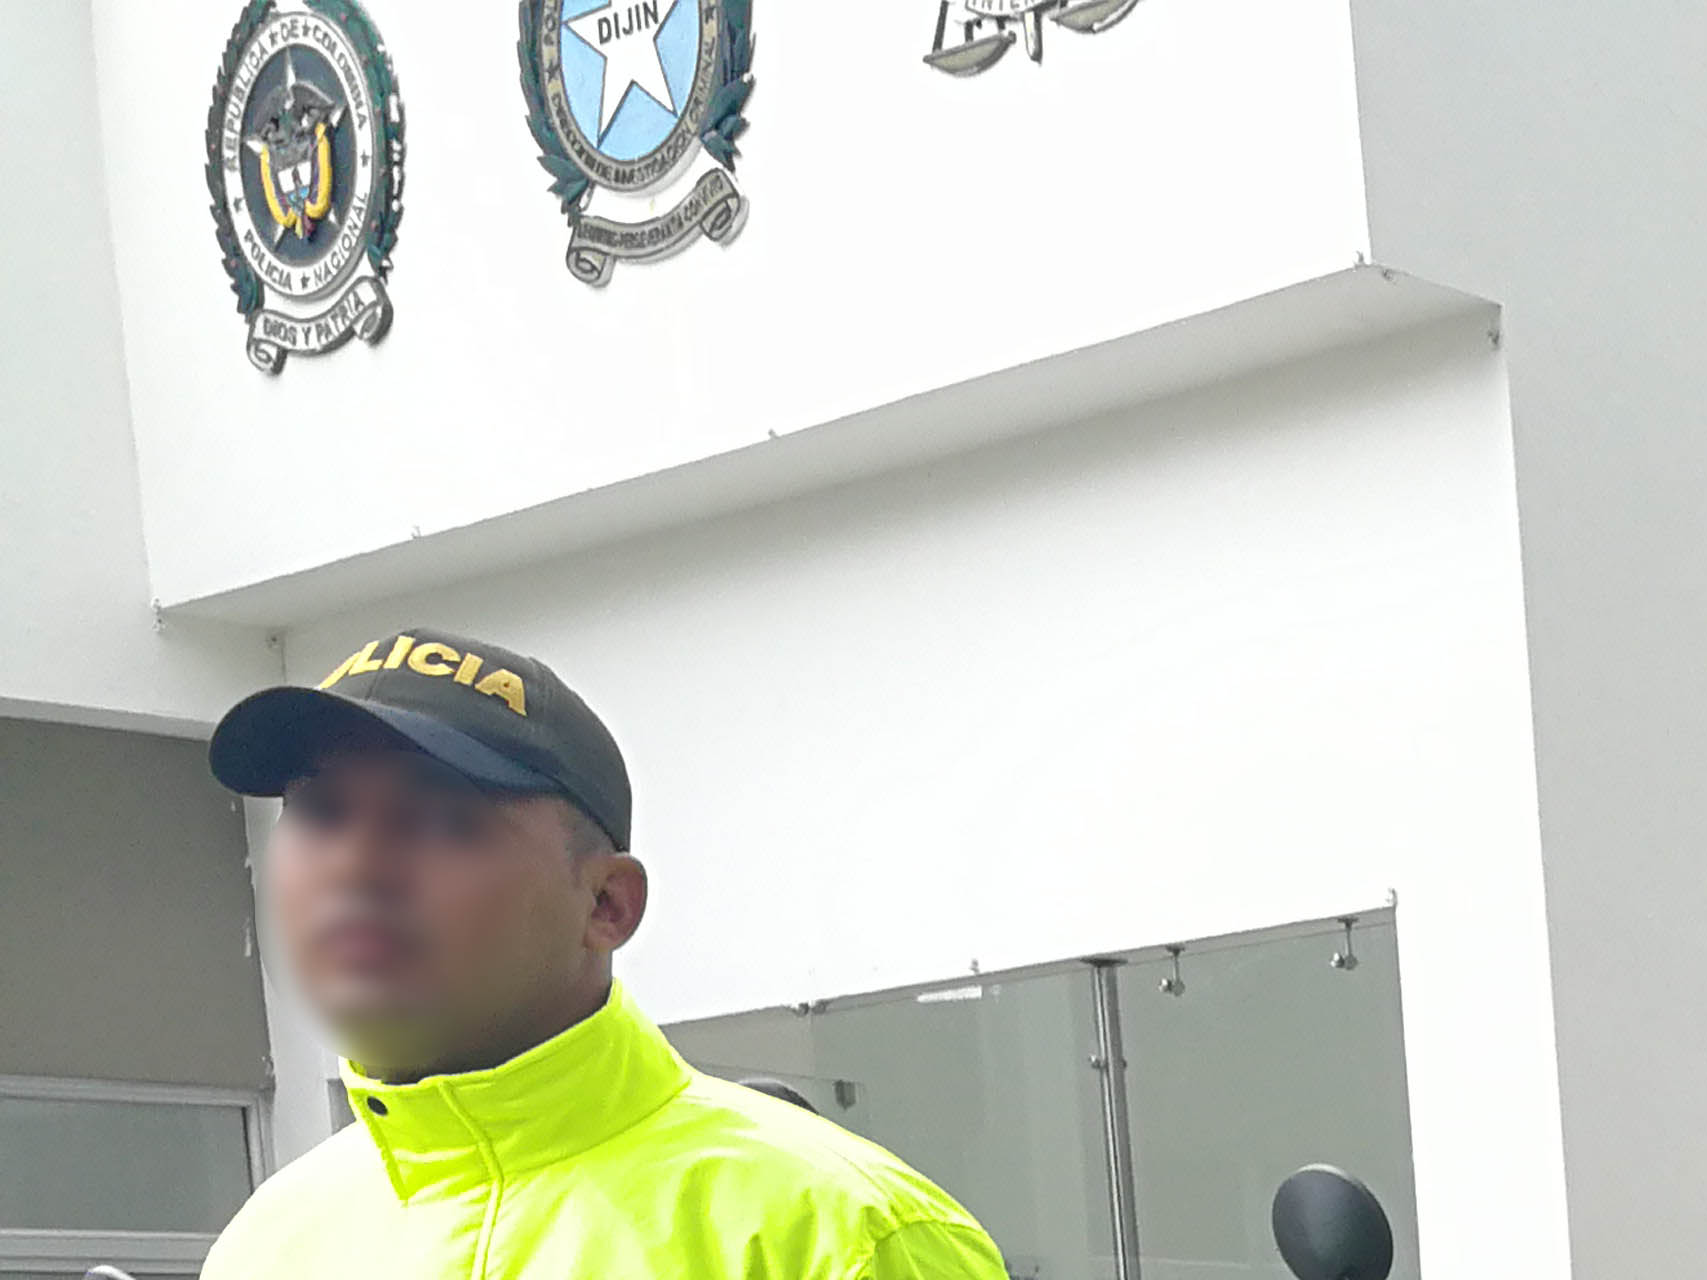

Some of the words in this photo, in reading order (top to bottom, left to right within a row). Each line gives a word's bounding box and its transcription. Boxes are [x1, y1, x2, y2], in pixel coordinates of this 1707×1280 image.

[597, 1, 659, 44] DIJIN
[225, 41, 271, 172] REPUBLICA
[280, 20, 299, 42] DE
[313, 24, 368, 130] COLOMBIA
[244, 229, 293, 292] POLICIA
[313, 193, 368, 288] NACIONAL
[263, 318, 297, 346] DIOS
[302, 323, 312, 347] Y
[315, 291, 365, 342] PATRIA
